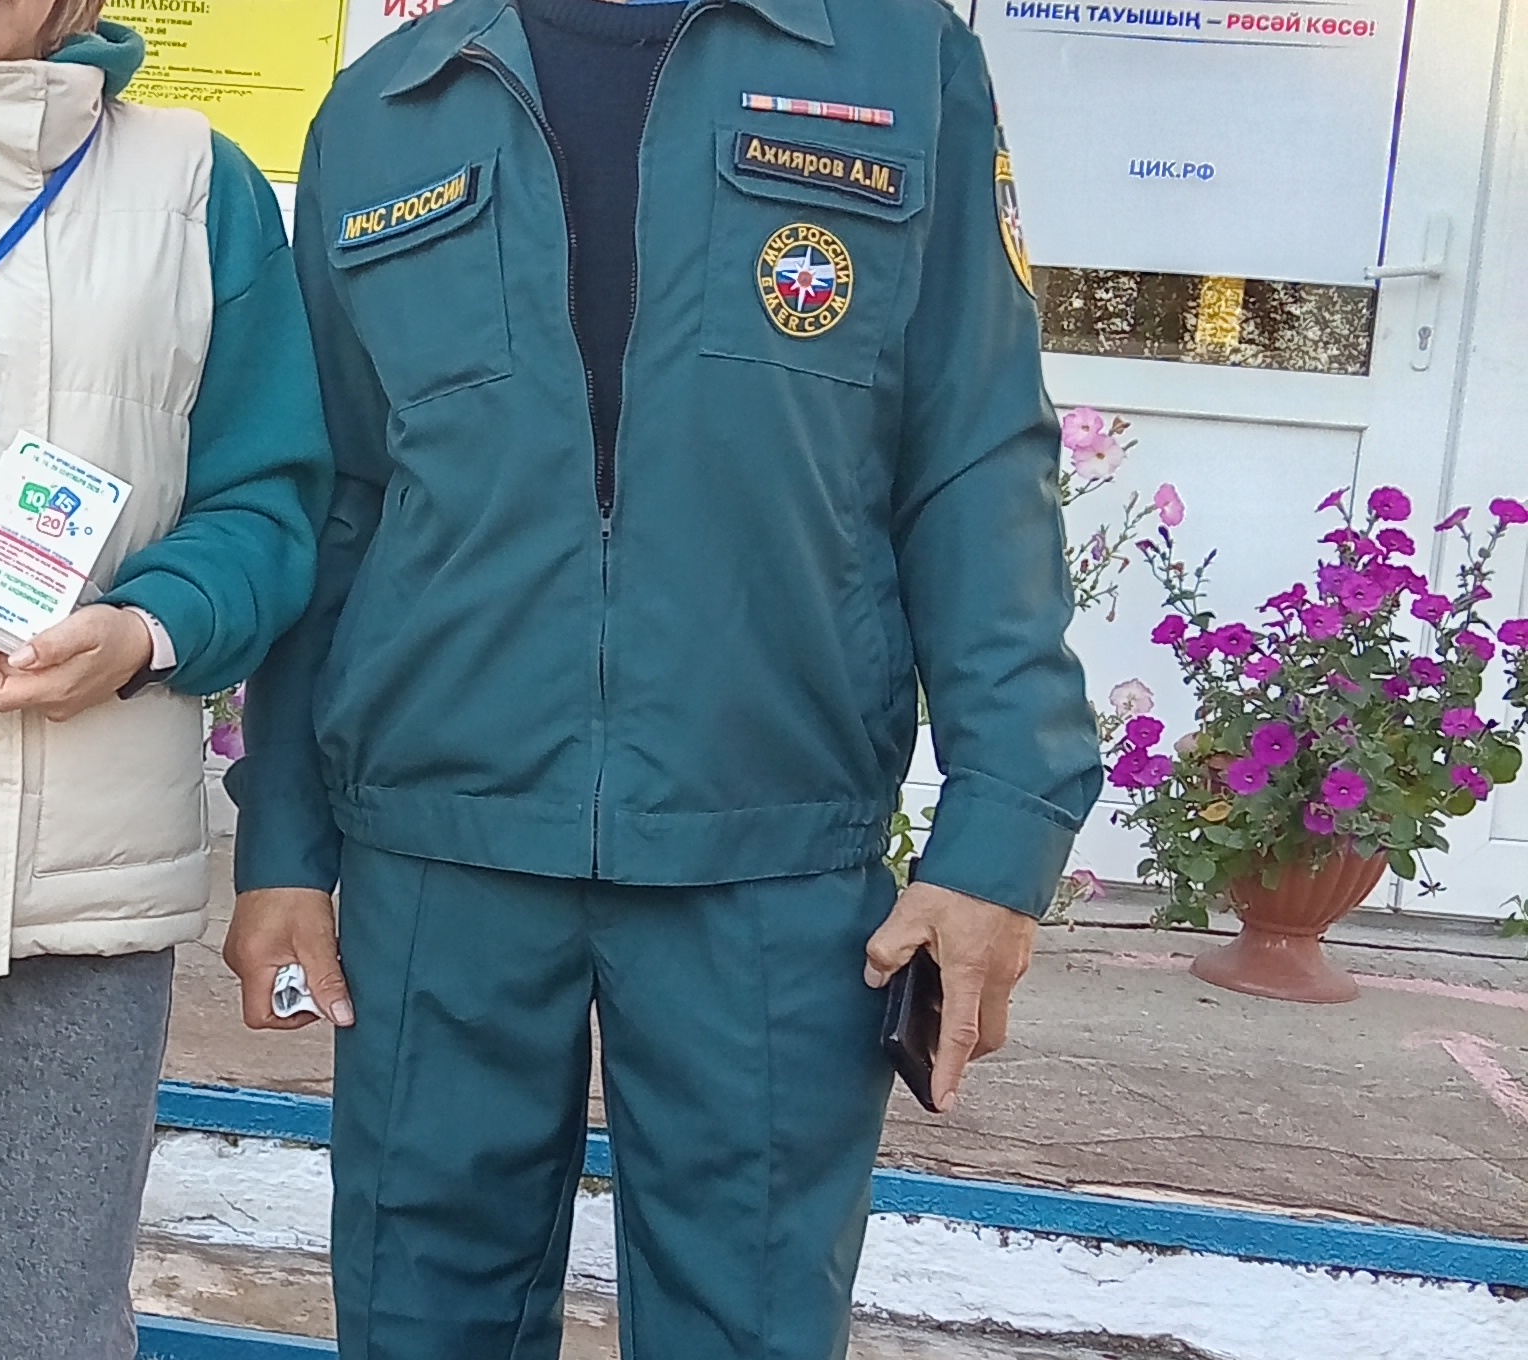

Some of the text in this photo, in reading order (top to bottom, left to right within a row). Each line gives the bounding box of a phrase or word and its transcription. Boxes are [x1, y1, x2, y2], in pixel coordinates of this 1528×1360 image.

[1086, 5, 1201, 30] ТАУЫШЫҢ
[1226, 12, 1302, 35] РӘСӘЙ
[1305, 17, 1377, 37] КӨСӨ!
[745, 138, 896, 194] Ахияров А.М.
[1128, 159, 1215, 181] ЦИК.РФ
[344, 172, 467, 240] МЧС РОССИИ
[763, 227, 851, 284] МЧС РОССИИ
[760, 276, 847, 332] EMERCOM
[24, 489, 76, 514] 10 15
[41, 515, 61, 531] 20
